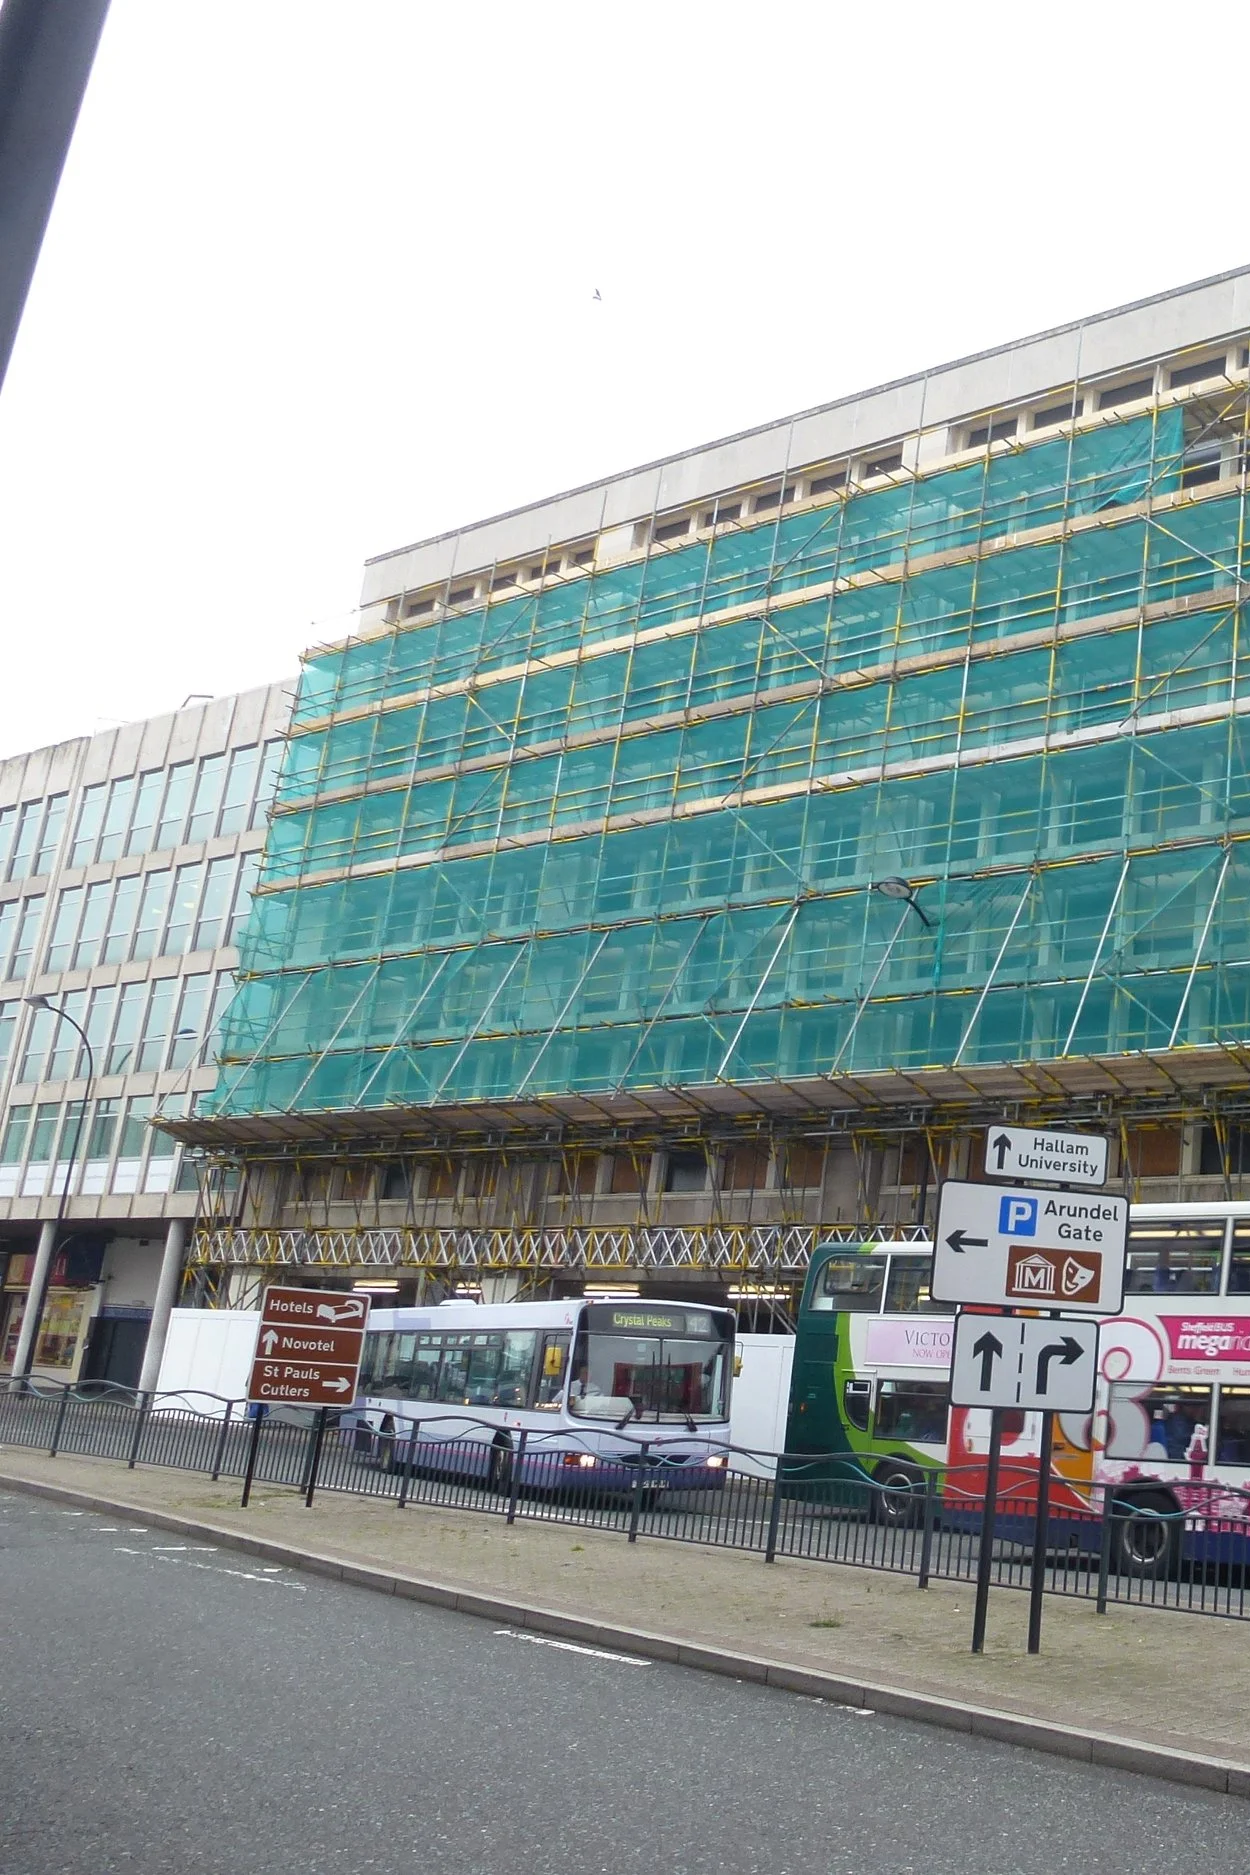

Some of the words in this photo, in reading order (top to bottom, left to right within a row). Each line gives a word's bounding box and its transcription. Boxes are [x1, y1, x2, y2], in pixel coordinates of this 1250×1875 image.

[1033, 1137, 1089, 1155] Hallam
[1018, 1154, 1098, 1177] University
[1007, 1200, 1032, 1231] P
[1044, 1199, 1119, 1221] Arundel
[1058, 1223, 1103, 1242] Gate
[269, 1299, 314, 1314] Hotels
[613, 1312, 645, 1327] Crystal
[646, 1314, 672, 1328] Peaks
[282, 1336, 335, 1352] Novotel
[905, 1329, 950, 1347] VICTO
[913, 1348, 933, 1359] NOW
[263, 1365, 280, 1378] St
[284, 1366, 320, 1380] Pauls
[260, 1383, 310, 1397] Cutlers
